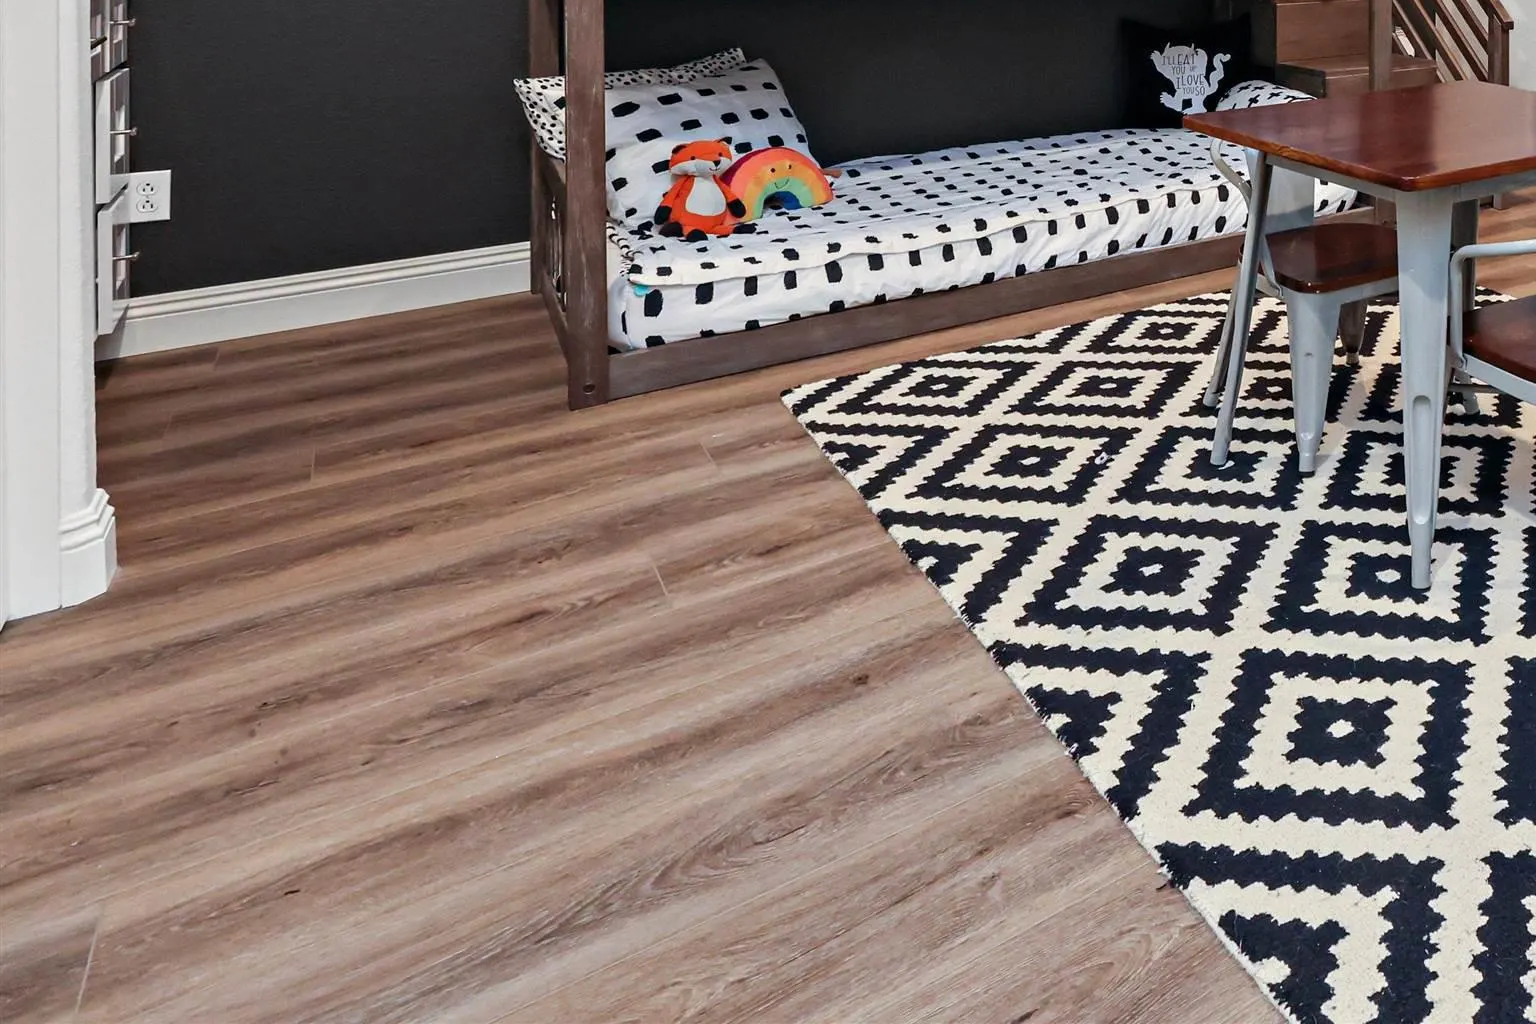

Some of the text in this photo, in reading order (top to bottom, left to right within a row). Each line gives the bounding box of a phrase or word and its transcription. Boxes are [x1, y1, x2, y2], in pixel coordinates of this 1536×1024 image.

[1177, 53, 1195, 65] EAT
[1172, 66, 1186, 75] YOU
[1176, 74, 1205, 90] I LOVE
[1183, 86, 1206, 96] YOU SO
